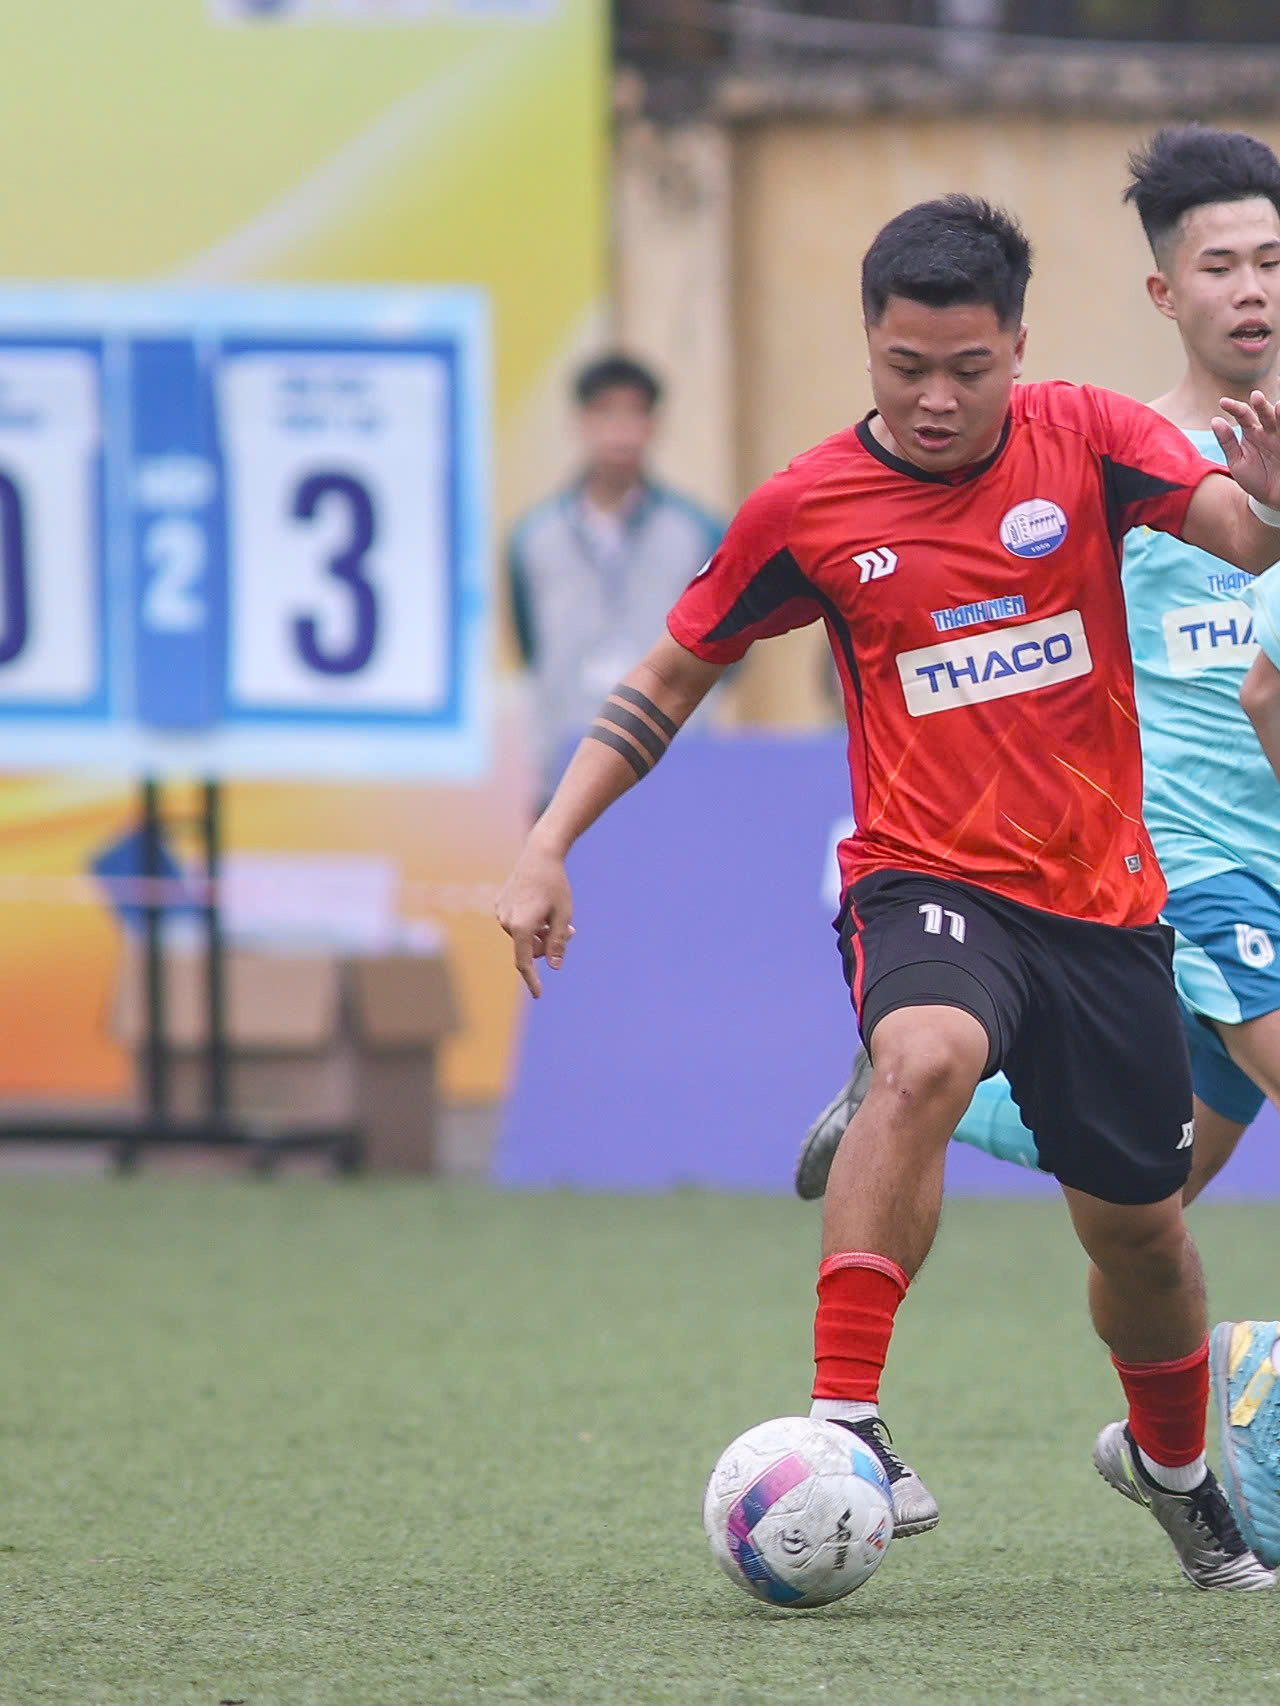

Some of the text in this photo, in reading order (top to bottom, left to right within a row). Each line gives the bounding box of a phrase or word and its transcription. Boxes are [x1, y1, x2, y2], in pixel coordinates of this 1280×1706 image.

[144, 518, 207, 633] 2
[293, 471, 380, 676] 3
[915, 633, 1072, 693] THACO
[918, 902, 966, 944] 11
[1234, 922, 1276, 969] 6
